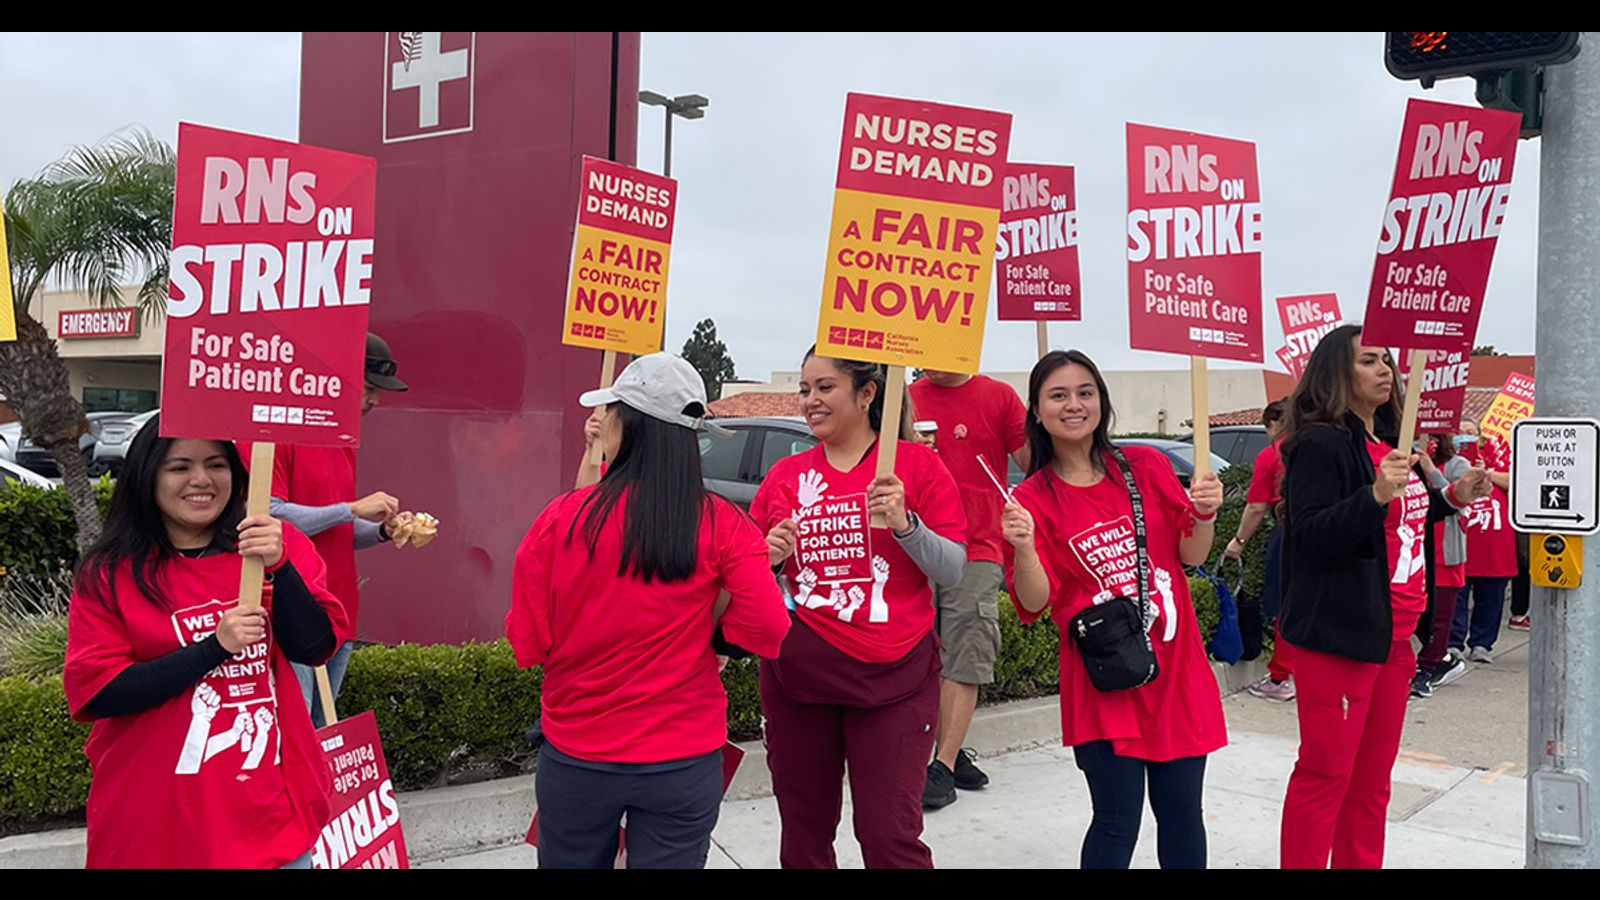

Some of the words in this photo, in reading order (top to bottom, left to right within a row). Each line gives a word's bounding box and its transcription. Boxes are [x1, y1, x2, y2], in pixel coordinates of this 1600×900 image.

[854, 113, 998, 156] NURSES
[1409, 120, 1483, 180] RNs
[1477, 157, 1502, 183] ON
[850, 146, 993, 187] DEMAND
[1144, 144, 1219, 194] RNs
[1220, 179, 1245, 201] ON
[200, 156, 317, 224] RNs
[317, 207, 352, 236] ON
[589, 171, 670, 208] NURSES
[1003, 173, 1050, 212] RNs
[1051, 194, 1067, 211] ON
[586, 195, 668, 229] DEMAND
[1377, 182, 1511, 255] STRIKE
[843, 220, 861, 240] A
[872, 208, 984, 255] FAIR
[995, 209, 1079, 261] STRIKE
[1127, 202, 1263, 263] STRIKE
[582, 247, 594, 262] A
[599, 239, 663, 275] FAIR
[837, 248, 980, 282] CONTRACT
[167, 239, 374, 318] STRIKE
[578, 267, 660, 294] CONTRACT
[1006, 264, 1023, 279] For
[1025, 264, 1049, 280] Safe
[1144, 269, 1172, 292] For
[1176, 272, 1214, 297] Safe
[1386, 261, 1412, 284] For
[1414, 263, 1447, 287] Safe
[833, 276, 975, 326] NOW!
[1006, 281, 1046, 296] Patient
[1048, 281, 1072, 296] Care
[1381, 286, 1437, 312] Patient
[1439, 291, 1471, 313] Care
[574, 286, 658, 324] NOW!
[1145, 292, 1208, 320] Patient
[1211, 301, 1248, 324] Care
[1285, 300, 1323, 327] RNs
[62, 311, 131, 334] EMERGENCY
[190, 327, 234, 359] For
[239, 332, 295, 363] Safe
[1448, 352, 1462, 364] ON
[188, 360, 283, 394] Patient
[289, 367, 342, 397] Care
[1434, 408, 1454, 418] Care
[1507, 402, 1529, 417] FA
[1536, 428, 1561, 439] PUSH
[1563, 428, 1577, 438] OR
[1535, 442, 1561, 453] WAVE
[1563, 442, 1577, 453] AT
[1537, 456, 1575, 467] BUTTON
[1546, 470, 1565, 480] FOR
[800, 505, 822, 517] WE
[826, 501, 861, 515] WILL
[800, 515, 862, 535] STRIKE
[1078, 534, 1100, 552] WE
[1100, 525, 1131, 543] WILL
[800, 536, 829, 550] FOR
[832, 532, 864, 546] OUR
[1086, 537, 1137, 566] STRIKE
[802, 547, 865, 563] PATIENTS
[1116, 554, 1138, 570] OU
[183, 614, 216, 632] WE
[334, 743, 375, 774] Patient
[362, 762, 379, 780] For
[334, 769, 360, 794] Safe
